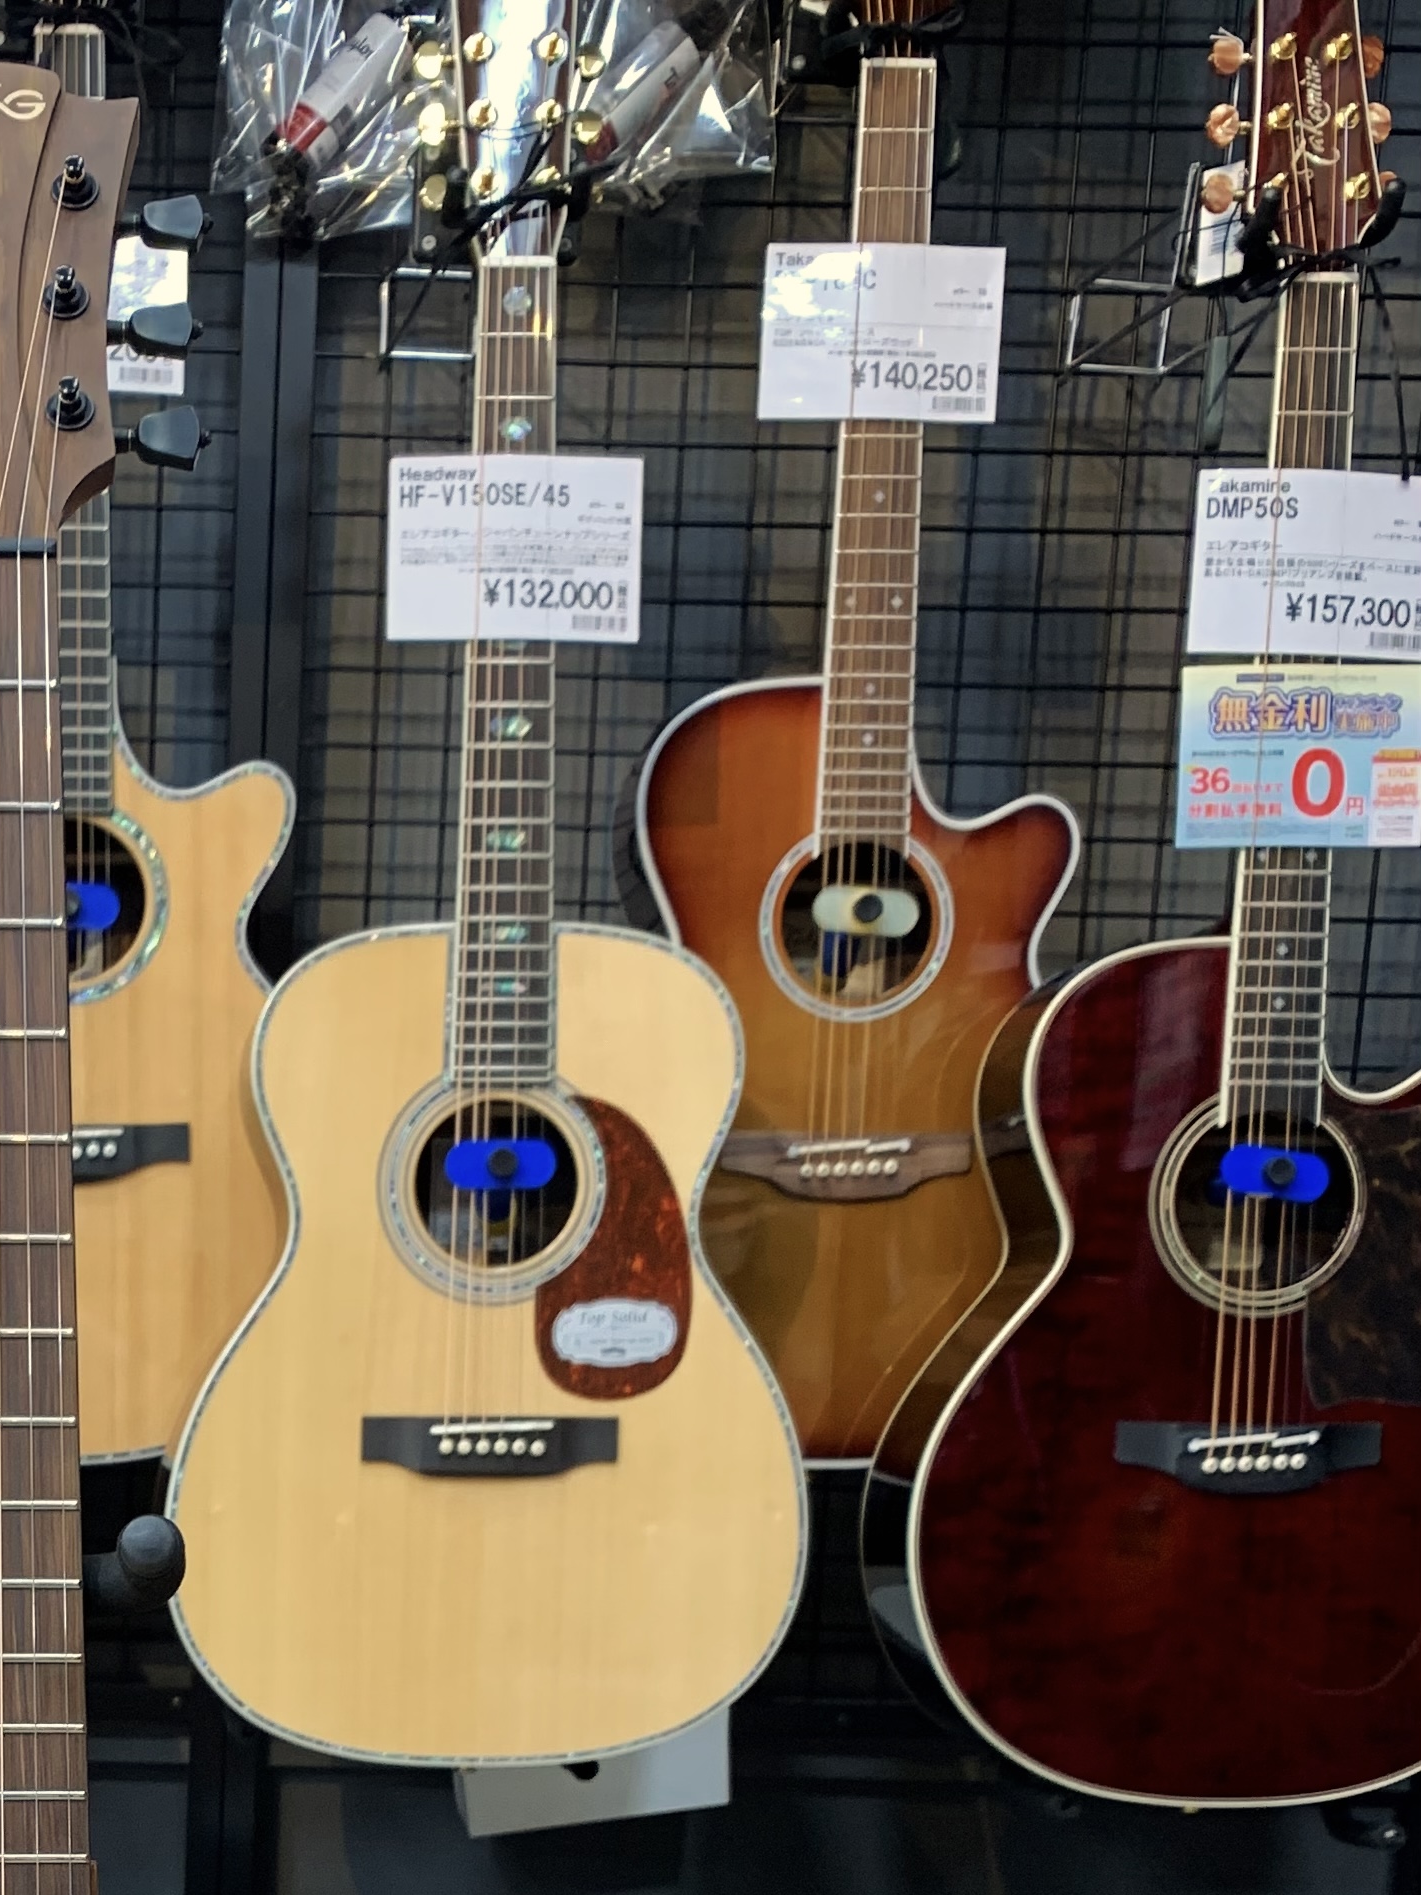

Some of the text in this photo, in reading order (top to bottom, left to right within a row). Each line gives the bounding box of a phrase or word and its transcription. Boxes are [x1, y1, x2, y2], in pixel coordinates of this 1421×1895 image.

[399, 467, 477, 483] Headway
[1206, 497, 1299, 519] DMP50S
[484, 578, 613, 610] ¥132,000
[1285, 592, 1411, 628] ¥157,300
[1213, 690, 1329, 734] 無金利
